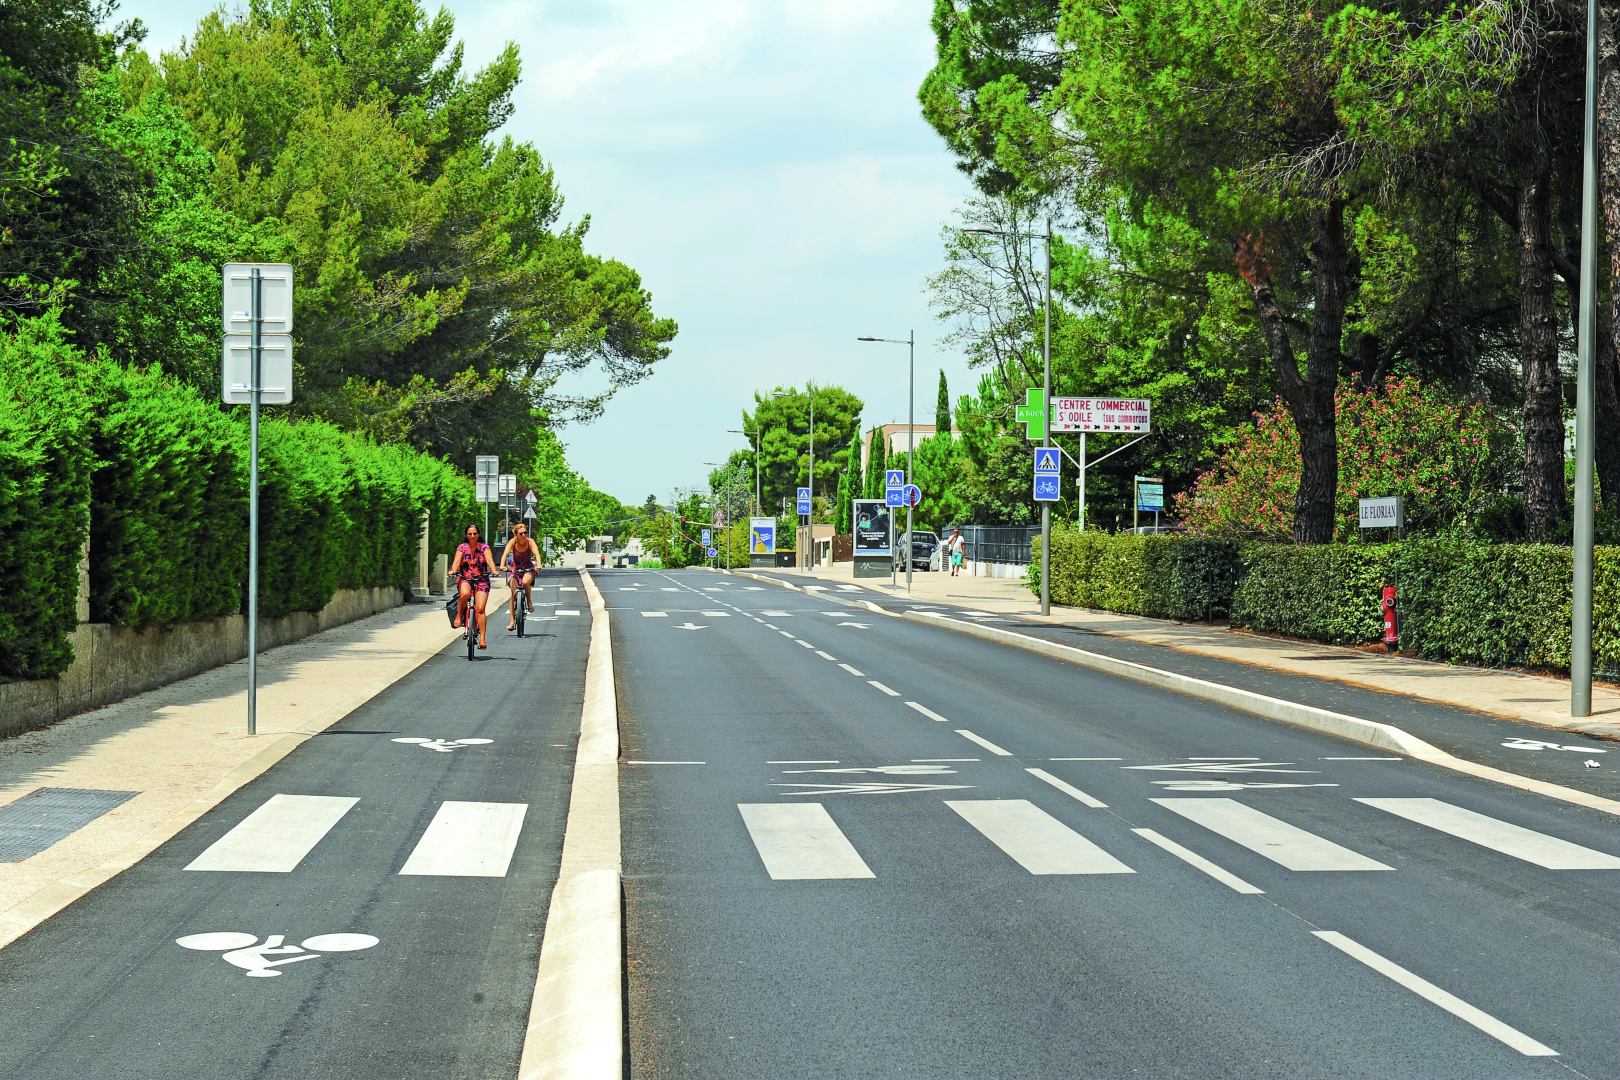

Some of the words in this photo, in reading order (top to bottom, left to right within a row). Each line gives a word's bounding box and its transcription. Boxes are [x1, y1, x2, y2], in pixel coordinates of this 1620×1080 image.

[1059, 399, 1091, 410] CENTRE
[1096, 400, 1148, 411] COMMERCIAL
[1068, 412, 1093, 422] ODILE
[1103, 413, 1115, 423] tous
[1118, 414, 1148, 424] commerces
[1361, 506, 1369, 519] LE
[1369, 505, 1396, 519] FLORIAN
